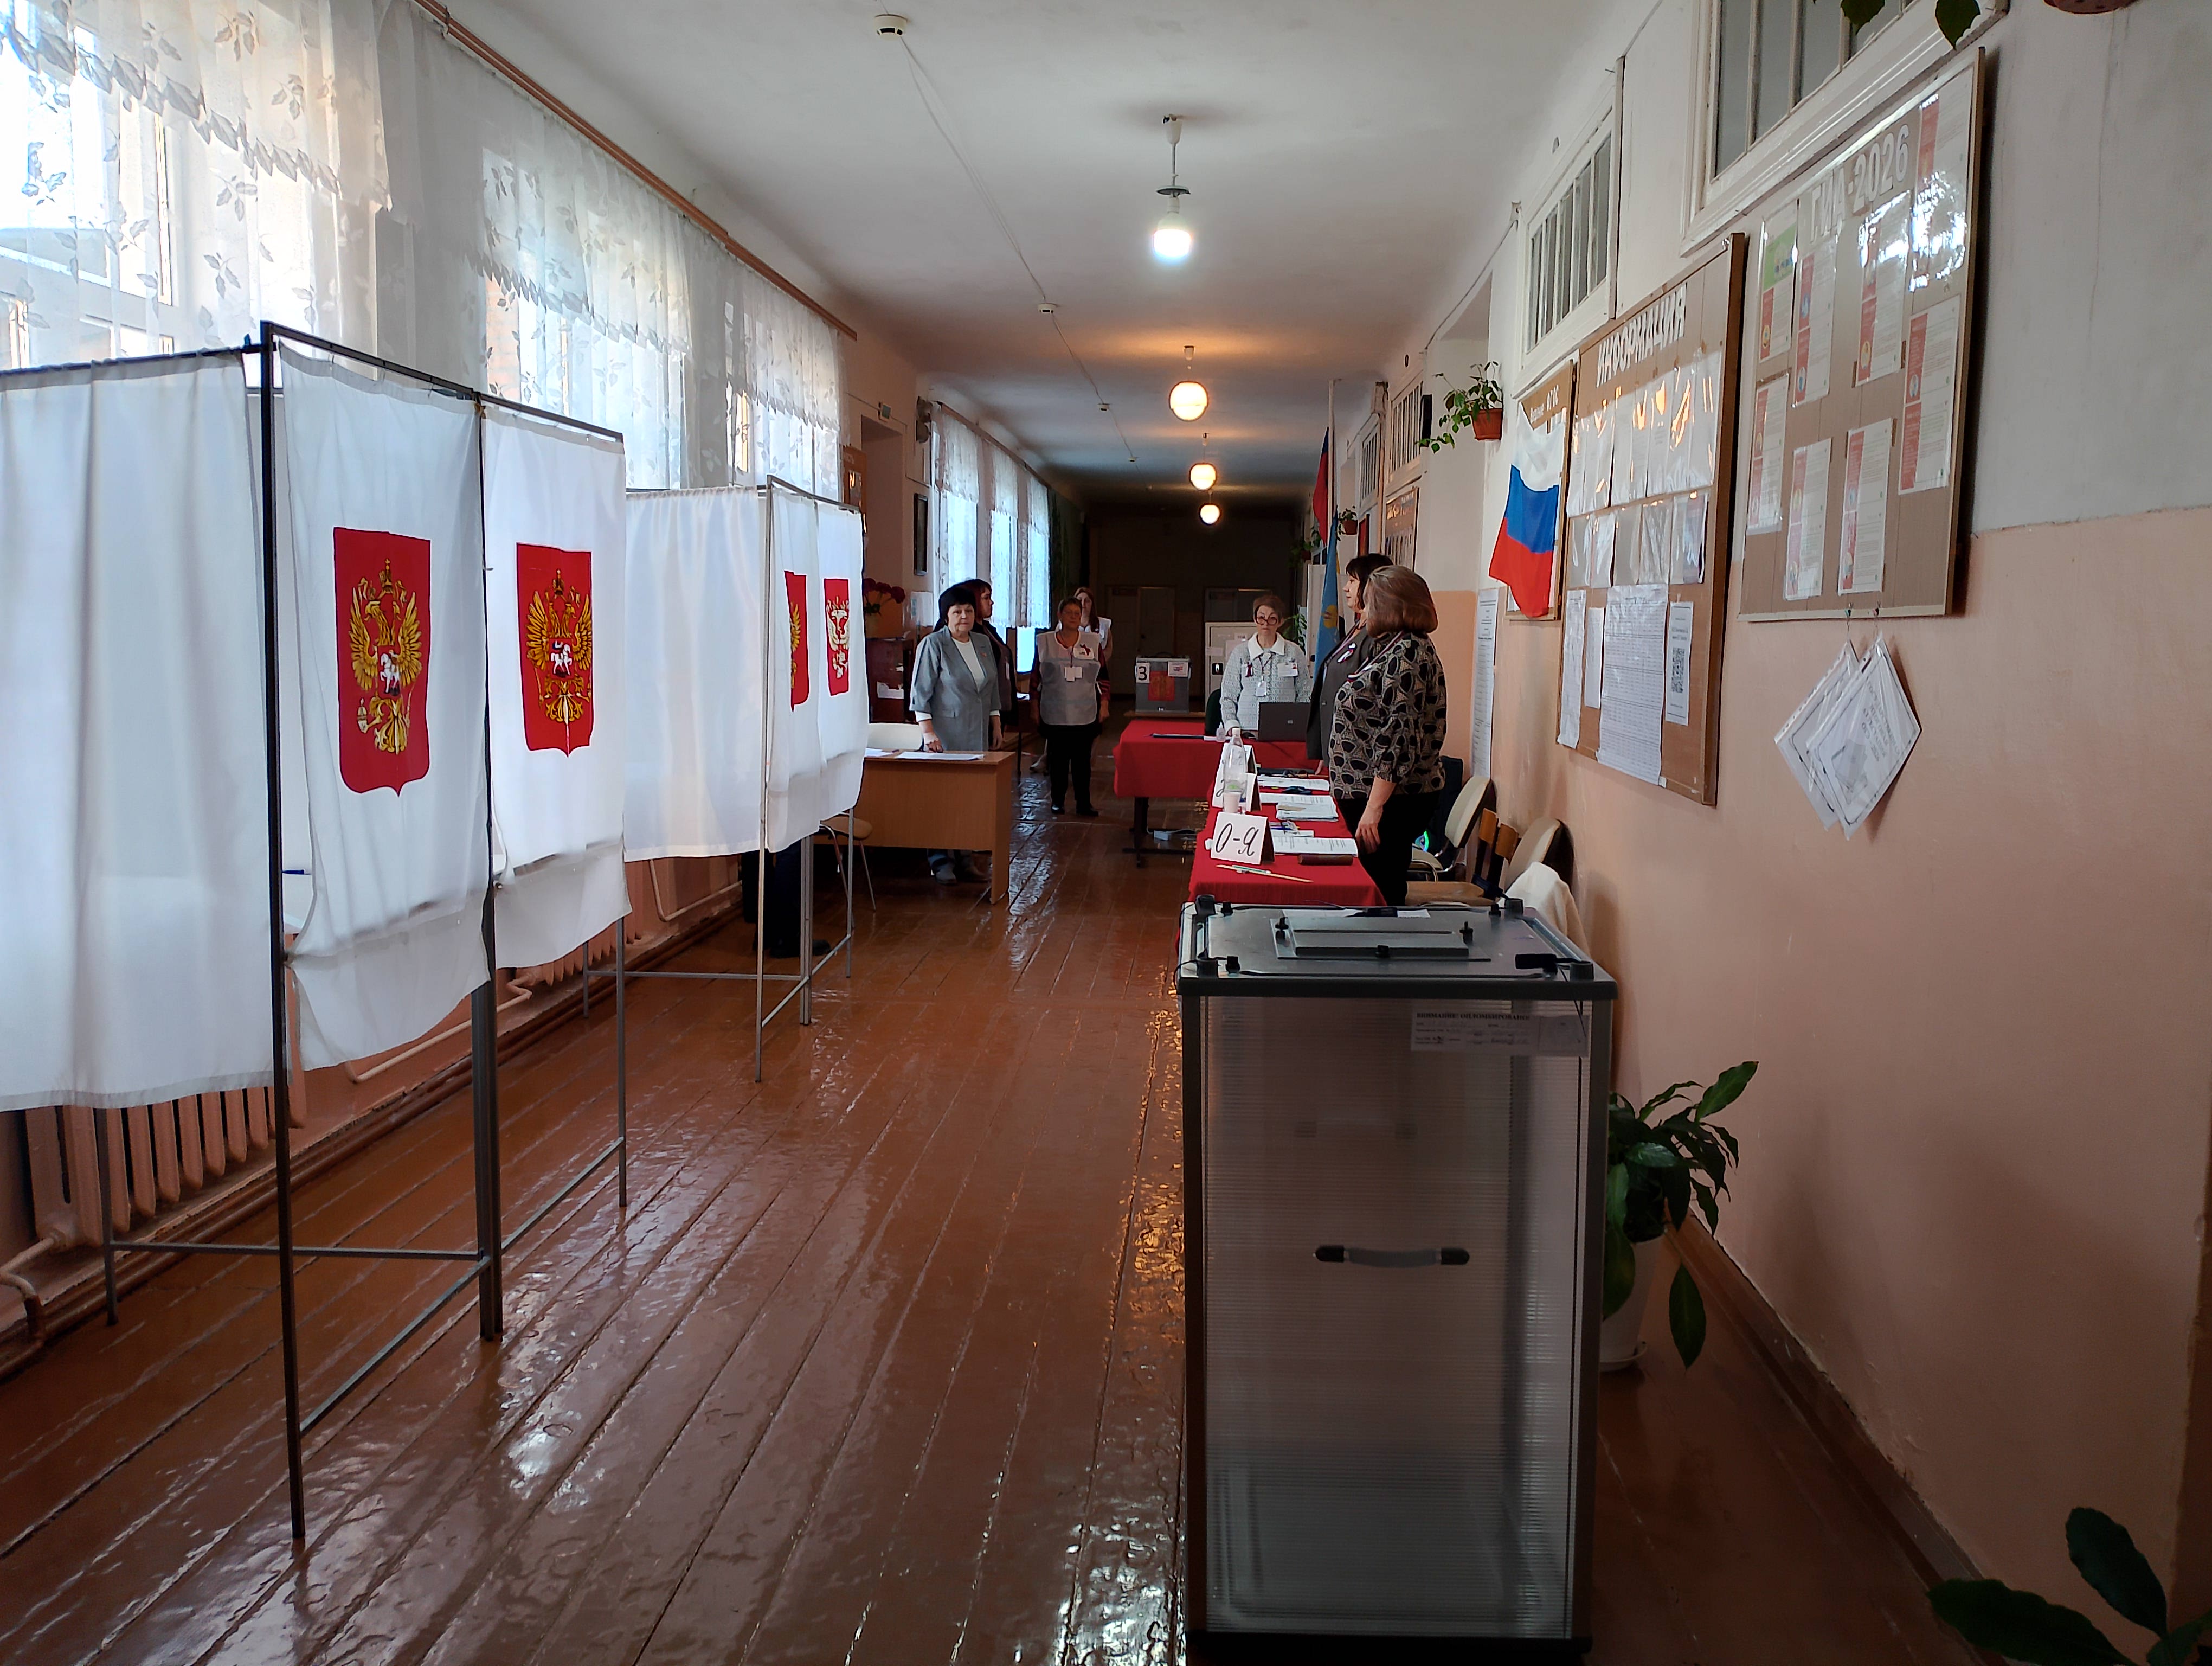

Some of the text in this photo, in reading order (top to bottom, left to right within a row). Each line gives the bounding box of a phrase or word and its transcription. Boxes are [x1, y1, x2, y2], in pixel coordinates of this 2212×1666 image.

[1810, 124, 1909, 244] ГИА-2026
[1596, 283, 1687, 388] ИНФОРМАЦИЯ
[1138, 665, 1148, 681] 3
